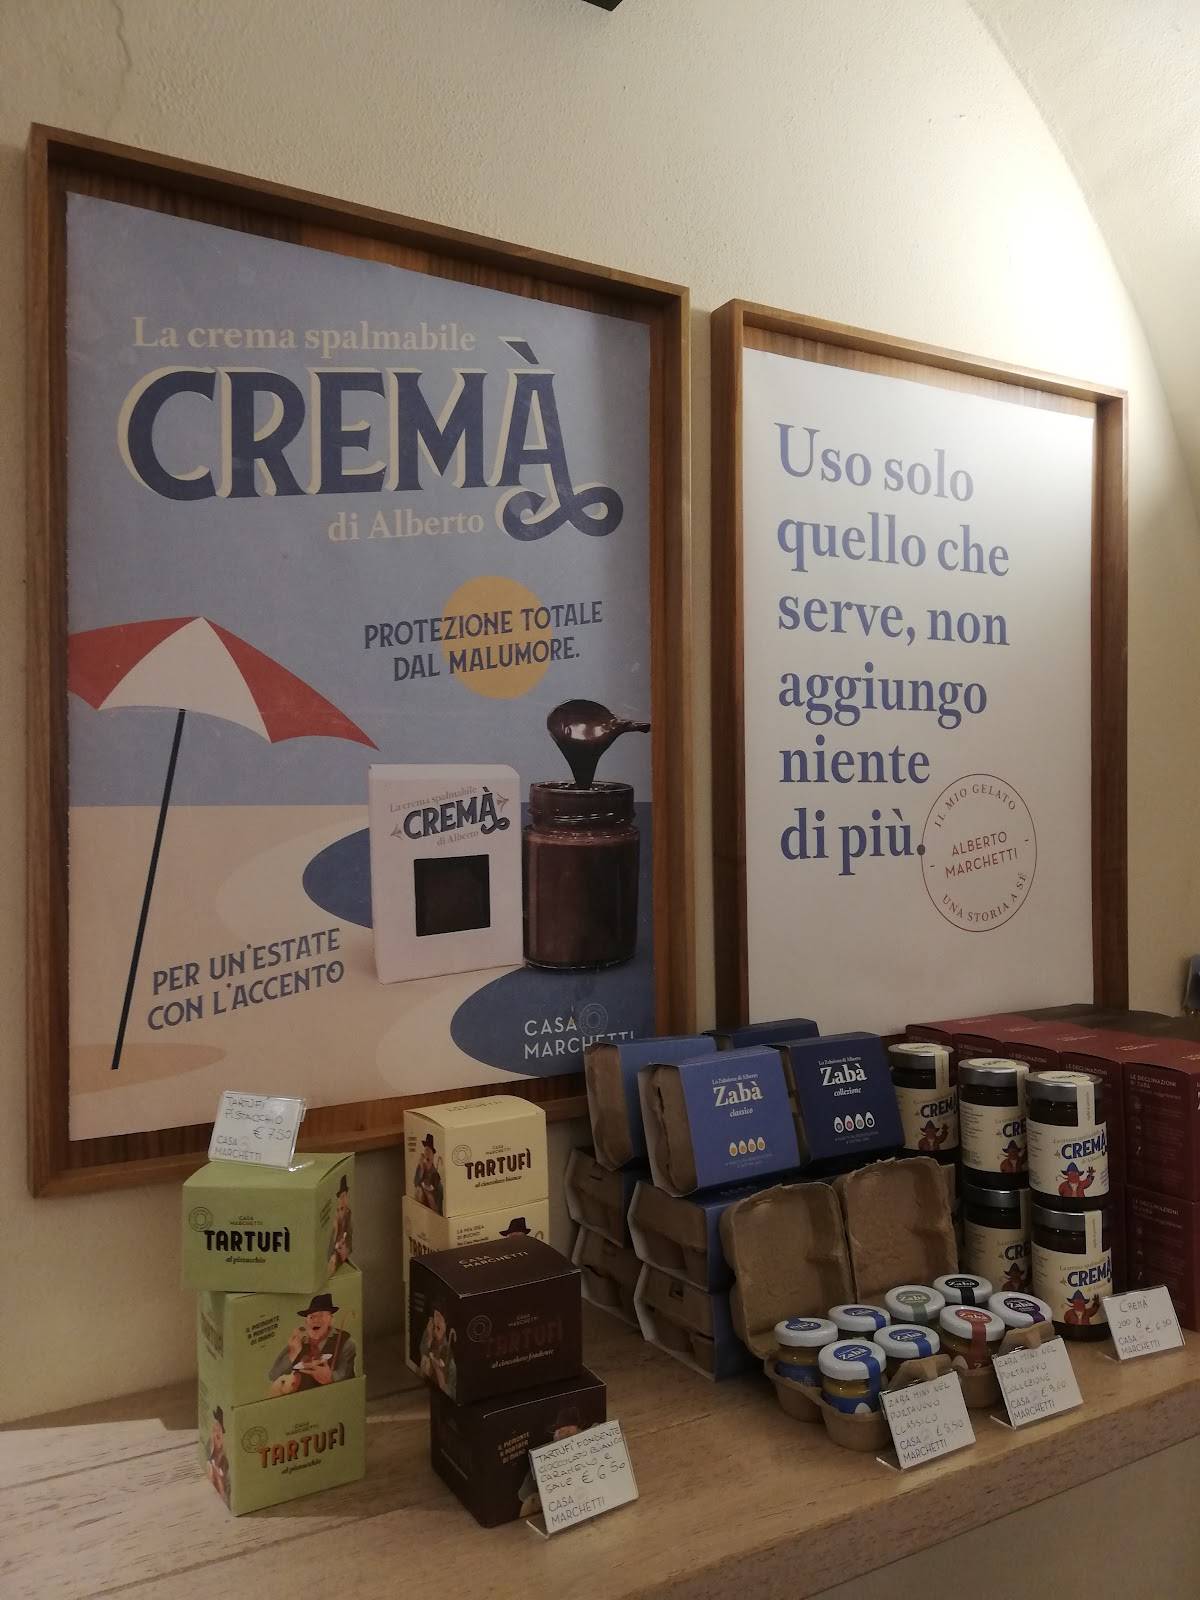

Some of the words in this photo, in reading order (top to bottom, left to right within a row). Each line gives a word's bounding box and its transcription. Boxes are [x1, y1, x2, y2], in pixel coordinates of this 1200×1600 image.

[132, 316, 180, 349] La
[187, 327, 296, 351] crema
[304, 321, 476, 359] spalmabile
[117, 336, 624, 542] CREMÀ
[774, 421, 873, 488] Uso
[884, 448, 975, 502] solo
[328, 511, 359, 542] di
[367, 507, 485, 541] Alberto
[777, 511, 927, 573] quello
[937, 523, 1011, 577] che
[363, 611, 513, 650] PROTEZIONE
[520, 600, 604, 632] TOTALE
[777, 593, 916, 647] serve,
[927, 604, 1011, 647] non
[393, 644, 441, 683] DAL
[447, 636, 581, 676] MALUMORE.
[778, 661, 988, 730] aggiungo
[778, 734, 931, 785] niente
[403, 785, 511, 840] CREMÀ
[934, 812, 947, 828] IL
[945, 787, 968, 811] MIO
[971, 783, 1016, 811] GELATO
[780, 807, 829, 861] di
[837, 807, 926, 876] più.
[951, 830, 1008, 857] ALBERTO
[944, 846, 1019, 880] MARCHETTI
[942, 893, 964, 919] UNA
[967, 901, 1011, 923] STORIA
[1010, 892, 1019, 903] A
[152, 960, 200, 995] PER
[208, 927, 341, 982] UN'ESTATE
[147, 993, 203, 1031] CON
[211, 960, 345, 1016] L'ACCENTO
[524, 1015, 578, 1037] CASA
[820, 1063, 868, 1086] Zabà
[713, 1081, 764, 1107] Zabà
[833, 1086, 862, 1097] collezione
[215, 1147, 262, 1161] MARCHETTI
[216, 1135, 237, 1146] CASA
[464, 1148, 531, 1180] TARTUFÌ
[204, 1227, 290, 1253] TARTUFÌ
[458, 1255, 491, 1266] CASA
[463, 1248, 528, 1269] MARCHETTI
[1118, 1335, 1137, 1345] CASA
[1121, 1339, 1161, 1355] MARCHETTI
[1010, 1397, 1031, 1409] CASA
[1012, 1399, 1055, 1420] MARCHETTI
[899, 1436, 922, 1450] CASA
[903, 1438, 947, 1463] MARCHETTI
[548, 1496, 574, 1512] CASA
[551, 1496, 605, 1528] MARCHETTI
